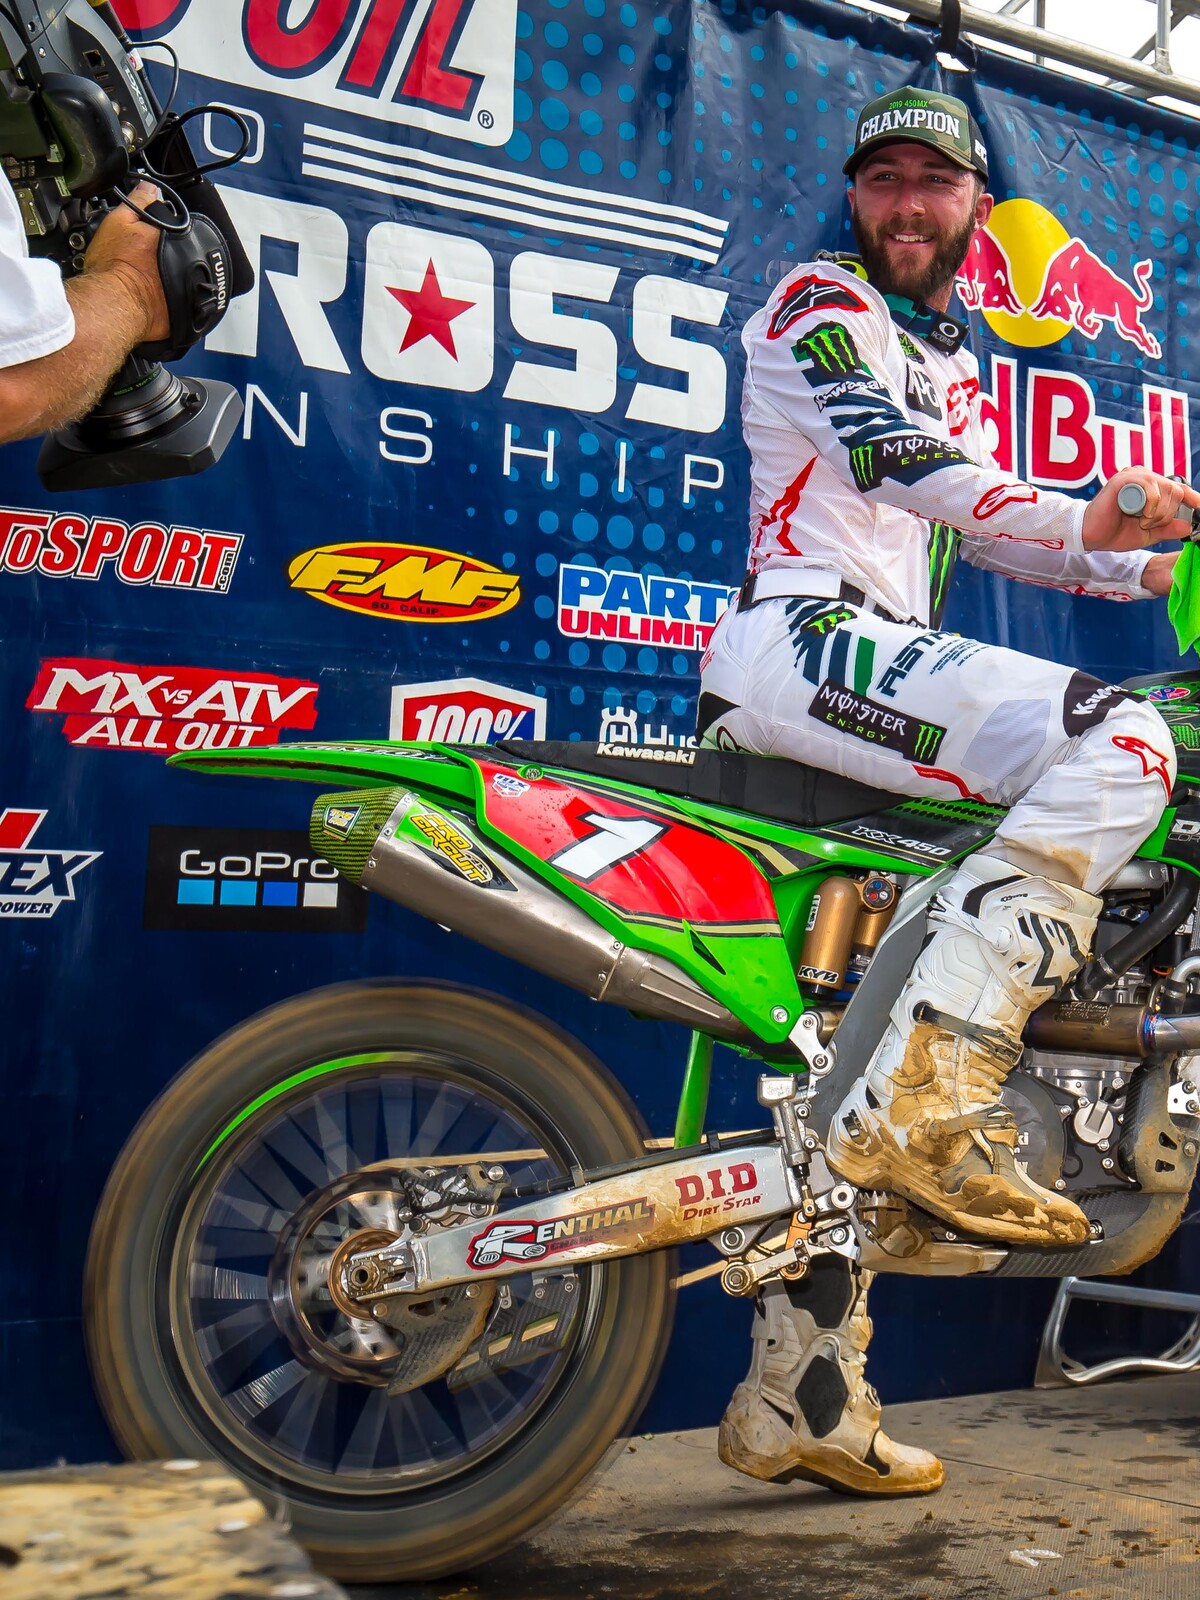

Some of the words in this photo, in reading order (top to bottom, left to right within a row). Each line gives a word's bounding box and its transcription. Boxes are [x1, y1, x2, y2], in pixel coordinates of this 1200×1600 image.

[888, 101, 903, 110] 2019
[860, 108, 961, 144] CHAMPION
[204, 184, 730, 434] ROSS
[242, 383, 726, 504] NSHIP
[883, 436, 961, 457] MONS
[1028, 367, 1191, 489] Bull
[289, 555, 520, 608] FMF
[561, 567, 740, 623] PART
[399, 603, 446, 617] CALIF.
[559, 608, 718, 651] UNLIMIT
[33, 667, 174, 718] MX
[177, 680, 319, 723] ATV
[71, 717, 169, 749] ALL
[175, 720, 265, 751] OUT
[413, 704, 526, 740] 100%
[596, 742, 696, 764] Kawasaki
[409, 814, 492, 884] CIRCUIT
[426, 812, 475, 849] PRO
[550, 812, 668, 882] 1
[179, 849, 340, 879] GoPro
[797, 964, 840, 985] KYB
[675, 1161, 759, 1207] D.I.D
[721, 1193, 763, 1213] STAR
